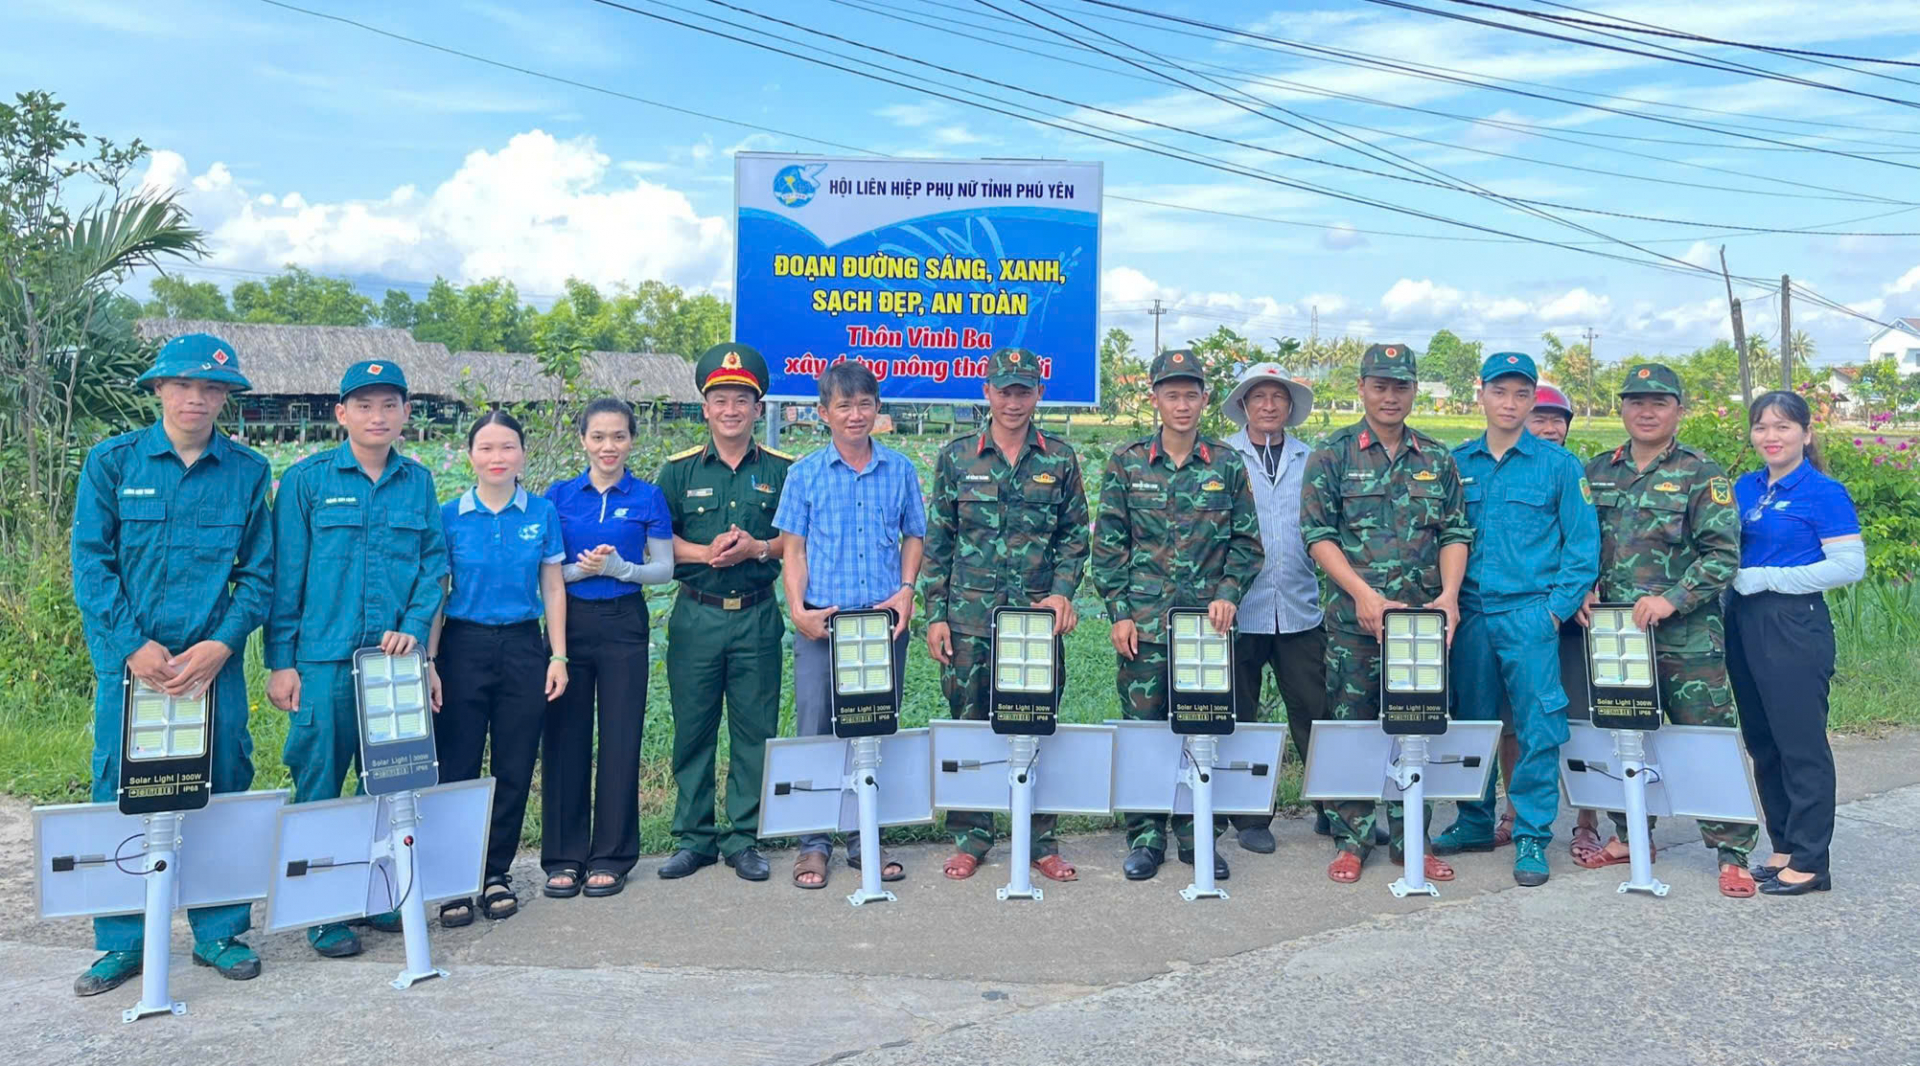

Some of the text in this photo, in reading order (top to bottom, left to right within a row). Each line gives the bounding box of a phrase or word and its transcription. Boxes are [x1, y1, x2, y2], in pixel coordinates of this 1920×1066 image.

[830, 177, 1074, 200] HỘI LIÊN HIỆP PHỤ NỮ TỈNH PHÚ YÊN
[774, 251, 1066, 284] ĐOẠN ĐƯỜNG SÁNG, XANH,
[812, 289, 1028, 317] SẠCH ĐẸP, AN TOÀN
[846, 324, 992, 349] Thôn Vinh Ba
[785, 352, 989, 382] xây ng nông thô
[129, 774, 175, 785] Solar Light
